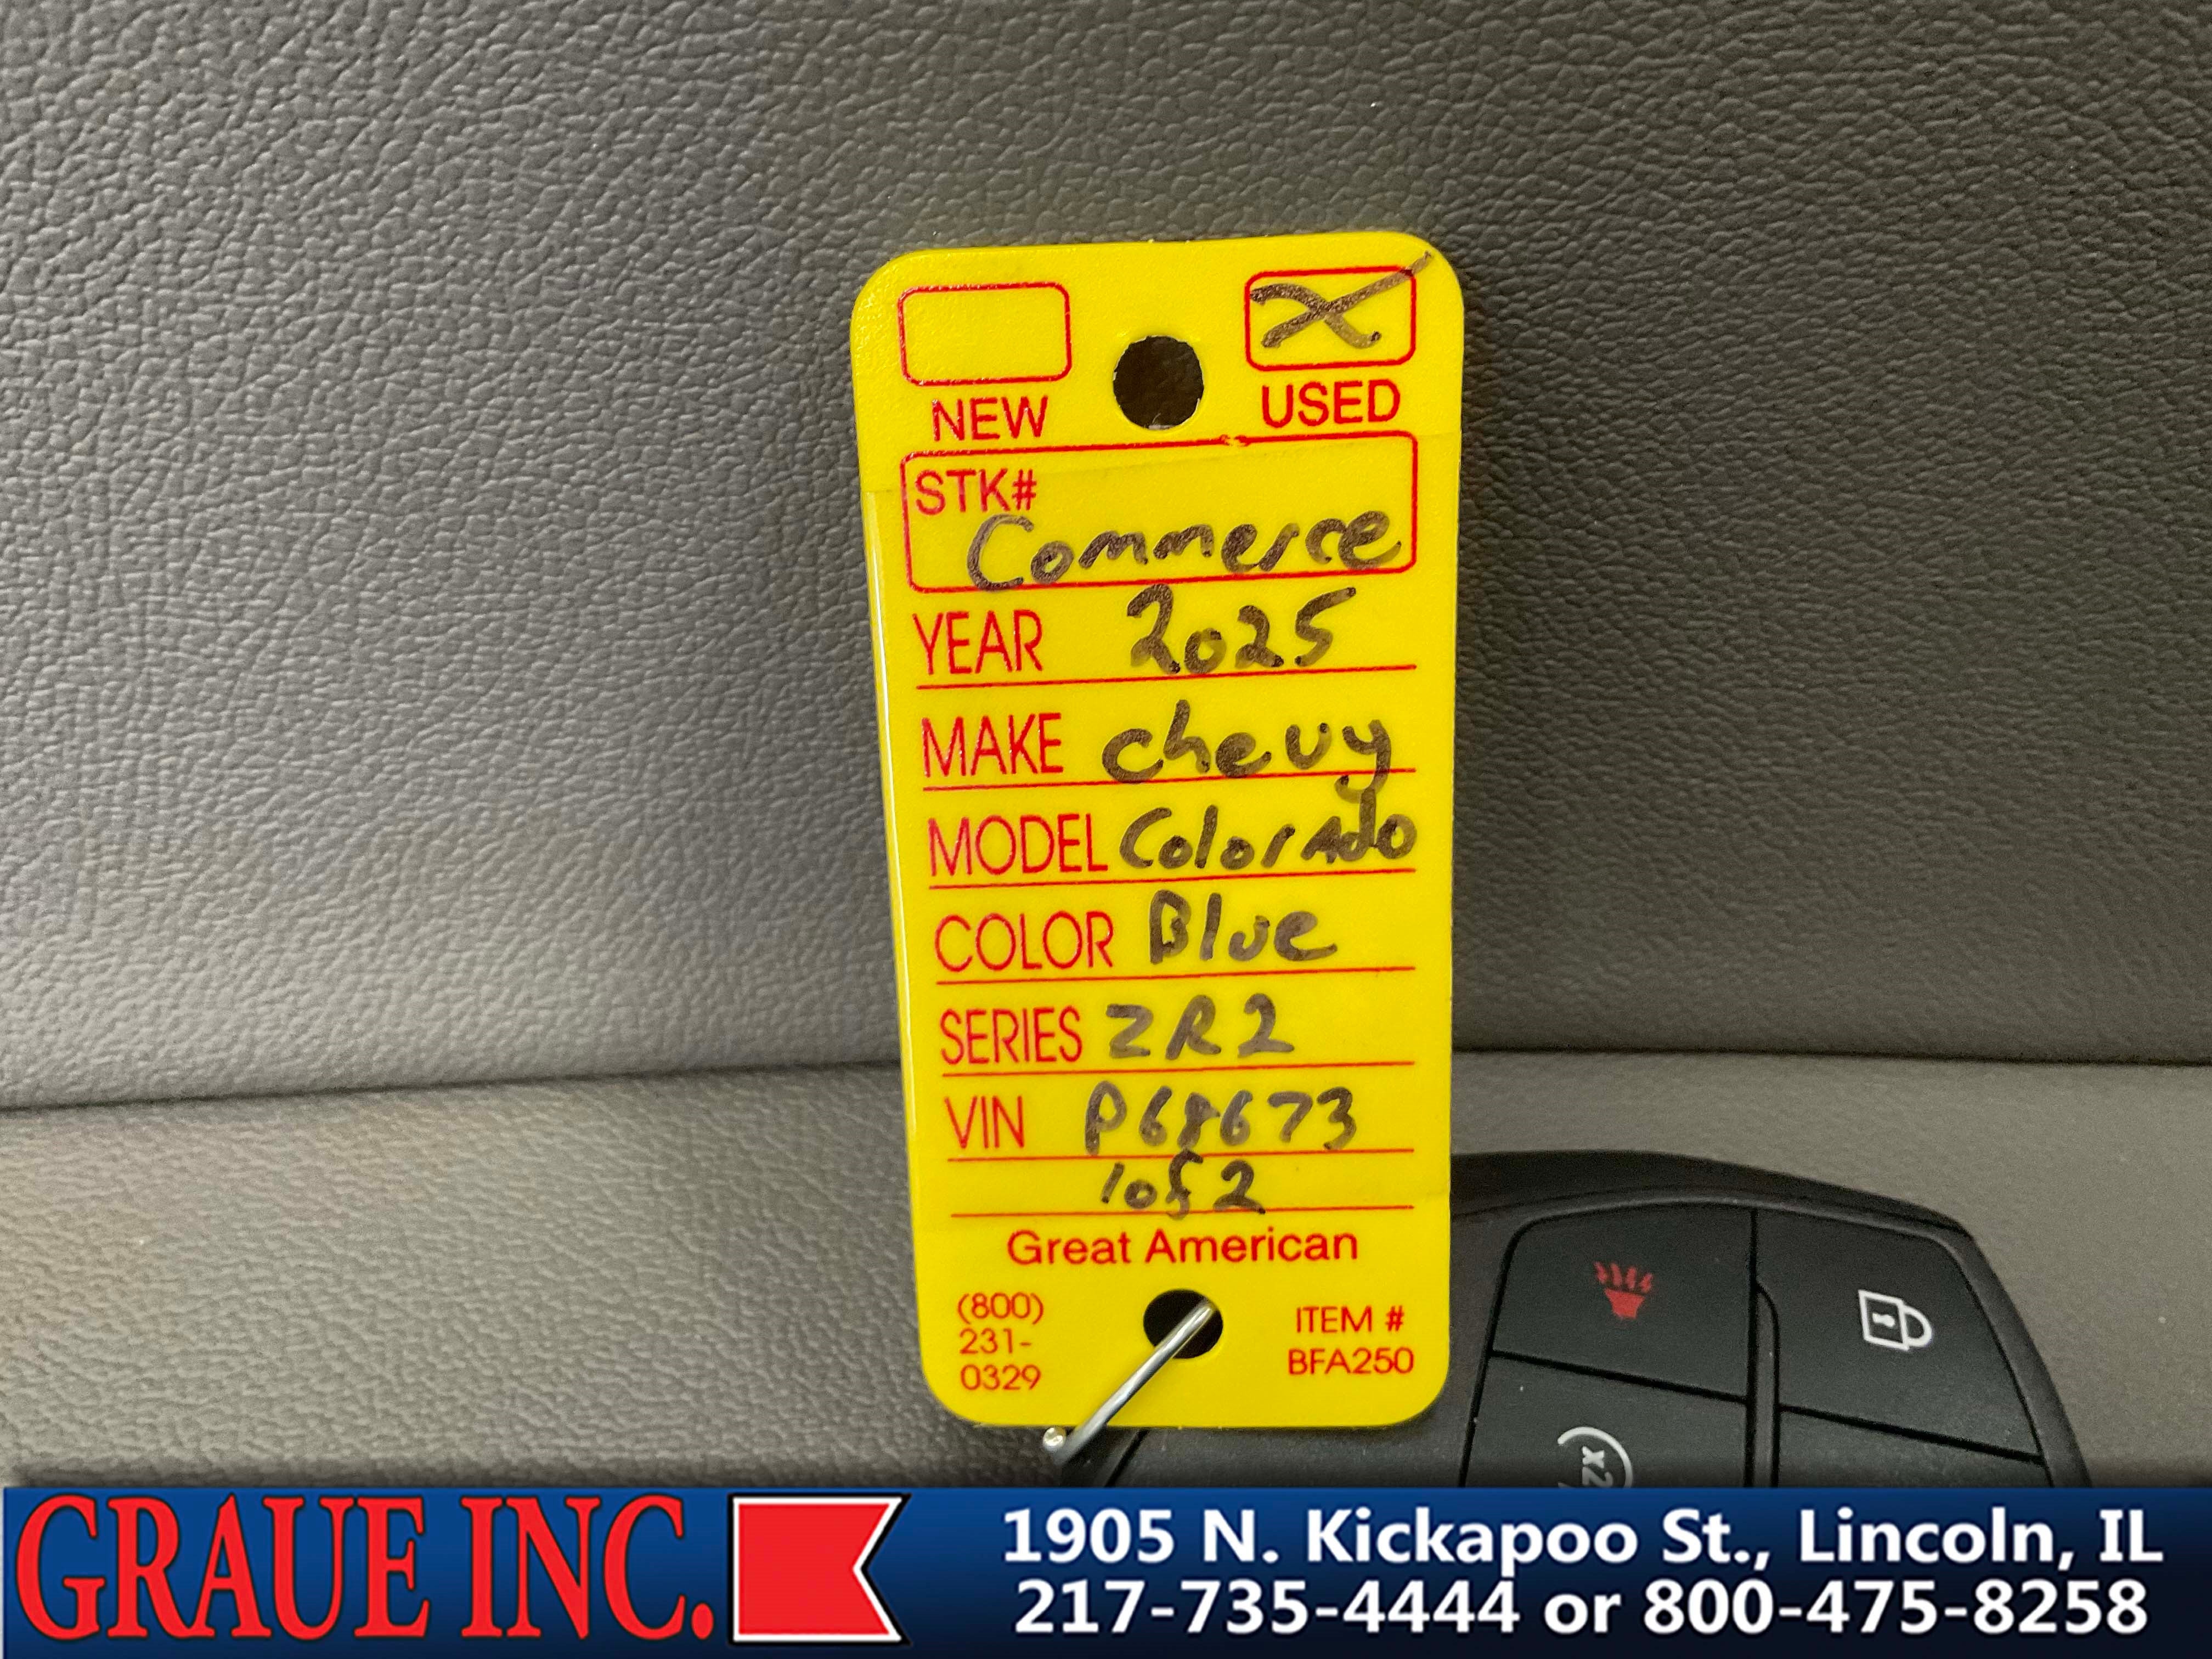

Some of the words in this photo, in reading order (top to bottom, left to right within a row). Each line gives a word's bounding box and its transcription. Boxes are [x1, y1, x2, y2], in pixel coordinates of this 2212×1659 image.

[931, 394, 1049, 443] NEW
[1261, 377, 1402, 428] USED
[914, 467, 1037, 514] STK#
[966, 510, 1402, 592] Commerce
[912, 608, 1043, 675] YEAR
[1126, 583, 1357, 675] 2025
[921, 712, 1064, 778] MAKE
[928, 812, 1109, 877] MODEL
[934, 909, 1114, 974] COLOR
[1148, 889, 1338, 966] Blue
[939, 1005, 1084, 1066] SERIES
[1105, 992, 1295, 1061] ZR2
[944, 1096, 1025, 1149] VIN
[1006, 1229, 1131, 1266] Great
[1144, 1226, 1358, 1263] American
[957, 1292, 1044, 1323] (800)
[1296, 1305, 1373, 1334] ITEM
[1386, 1306, 1405, 1332] #
[960, 1327, 1033, 1355] 231-
[1288, 1346, 1415, 1376] BFA250
[960, 1364, 1041, 1391] 0329
